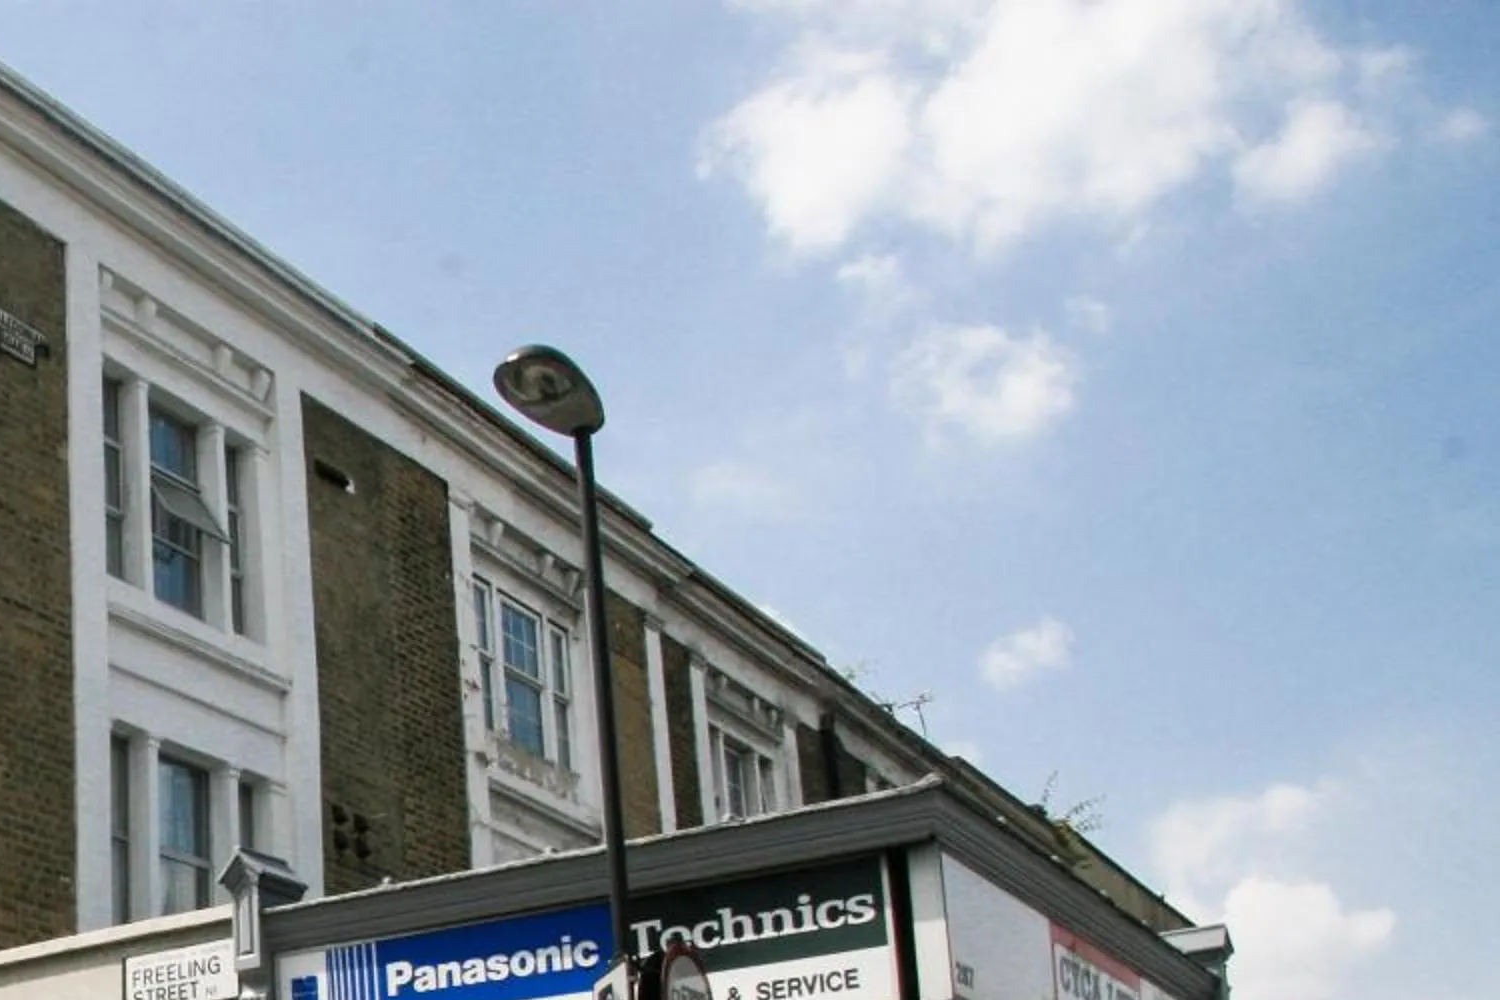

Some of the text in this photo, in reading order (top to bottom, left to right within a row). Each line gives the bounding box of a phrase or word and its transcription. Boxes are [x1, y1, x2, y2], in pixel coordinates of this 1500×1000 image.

[630, 893, 878, 960] Technics
[131, 955, 221, 988] FREELING
[385, 934, 600, 997] Panasonic
